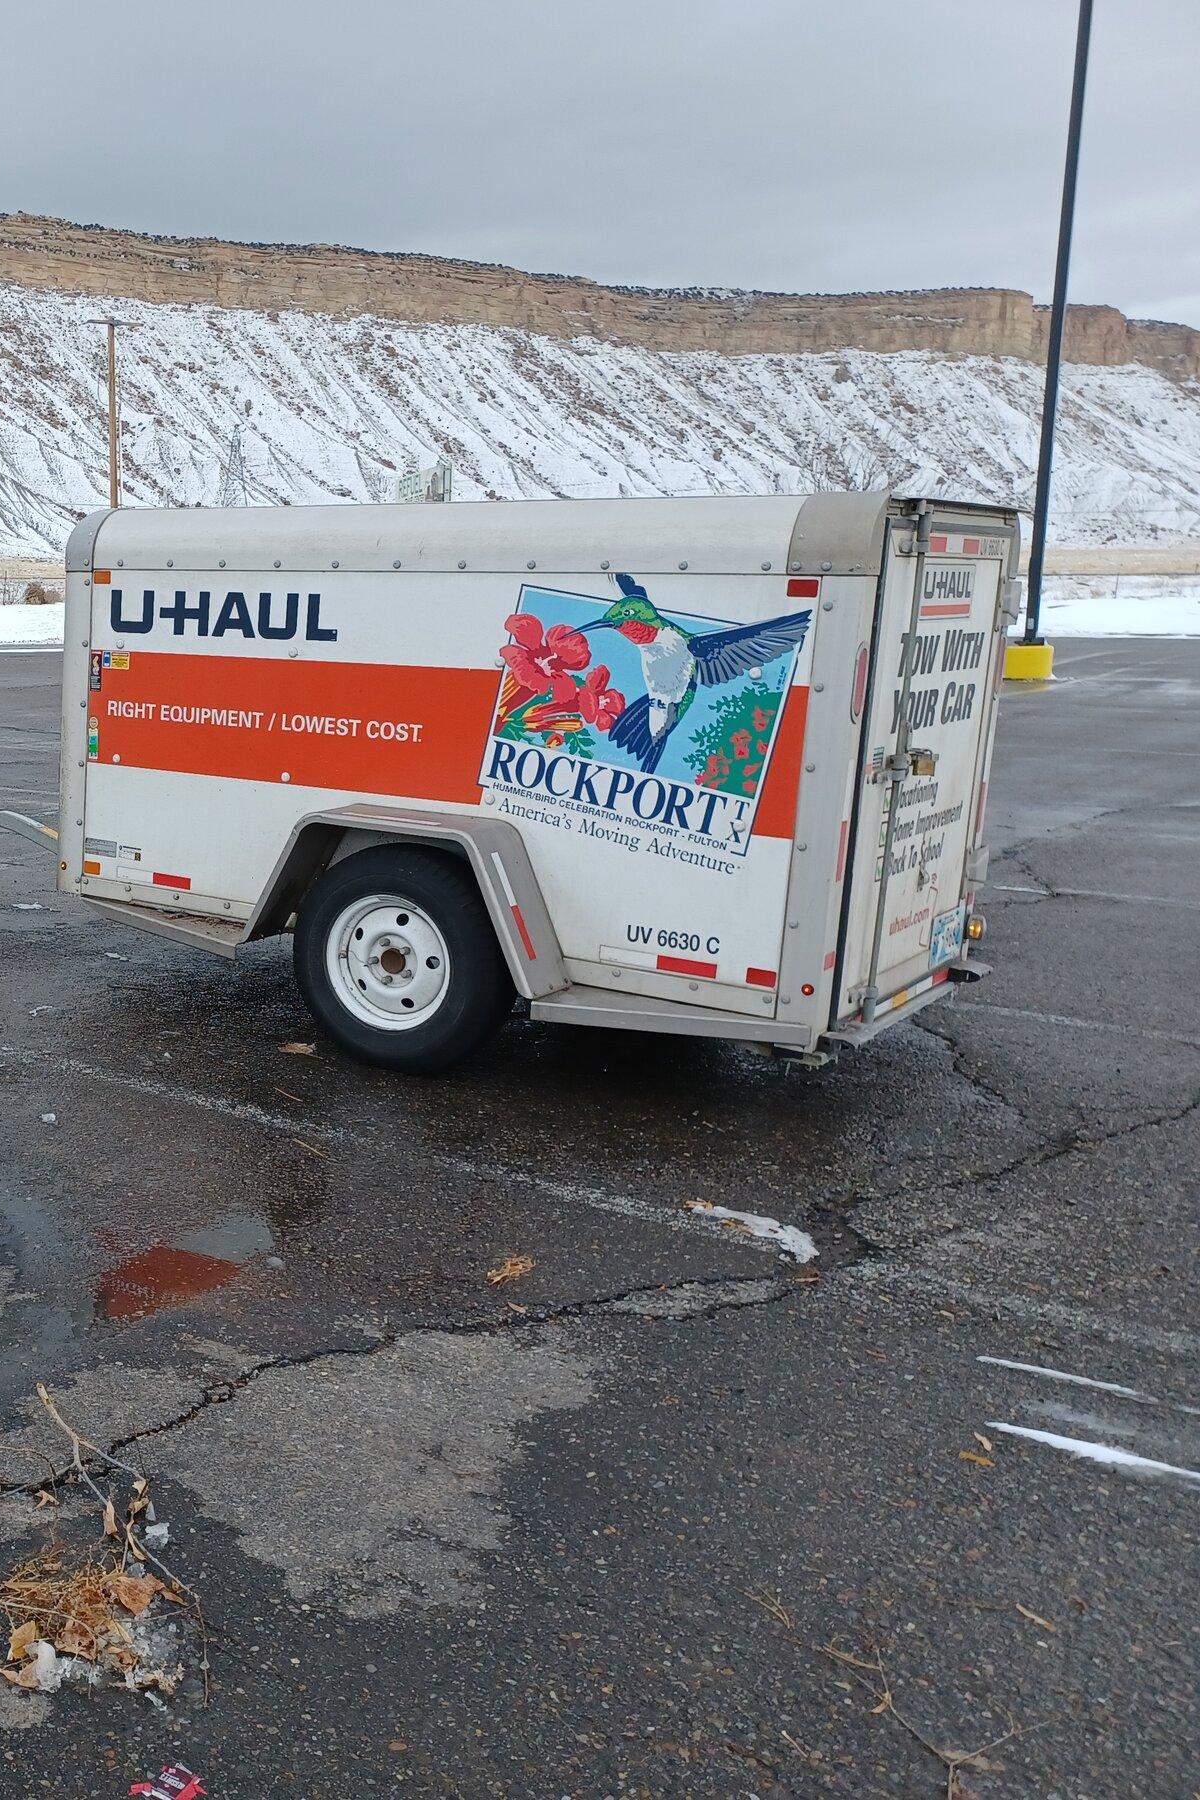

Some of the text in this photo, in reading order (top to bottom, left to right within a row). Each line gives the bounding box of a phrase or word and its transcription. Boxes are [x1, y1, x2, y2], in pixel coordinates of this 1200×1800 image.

[924, 571, 971, 599] U-HAUL
[110, 589, 338, 642] U-HAUL
[107, 700, 157, 720] RIGHT
[160, 704, 264, 730] EQUIPMENT
[268, 712, 277, 732] /
[281, 713, 362, 738] LOWEST
[940, 681, 976, 725] CAR
[485, 740, 728, 836] ROCKPORT
[492, 782, 557, 806] HUMMER/BIRD
[558, 799, 623, 823] CELEBRATION
[624, 816, 680, 838] ROCKPORT
[687, 833, 728, 851] FULTON
[498, 798, 735, 875] America's Moving Adventure
[626, 924, 721, 955] UV 6630 C
